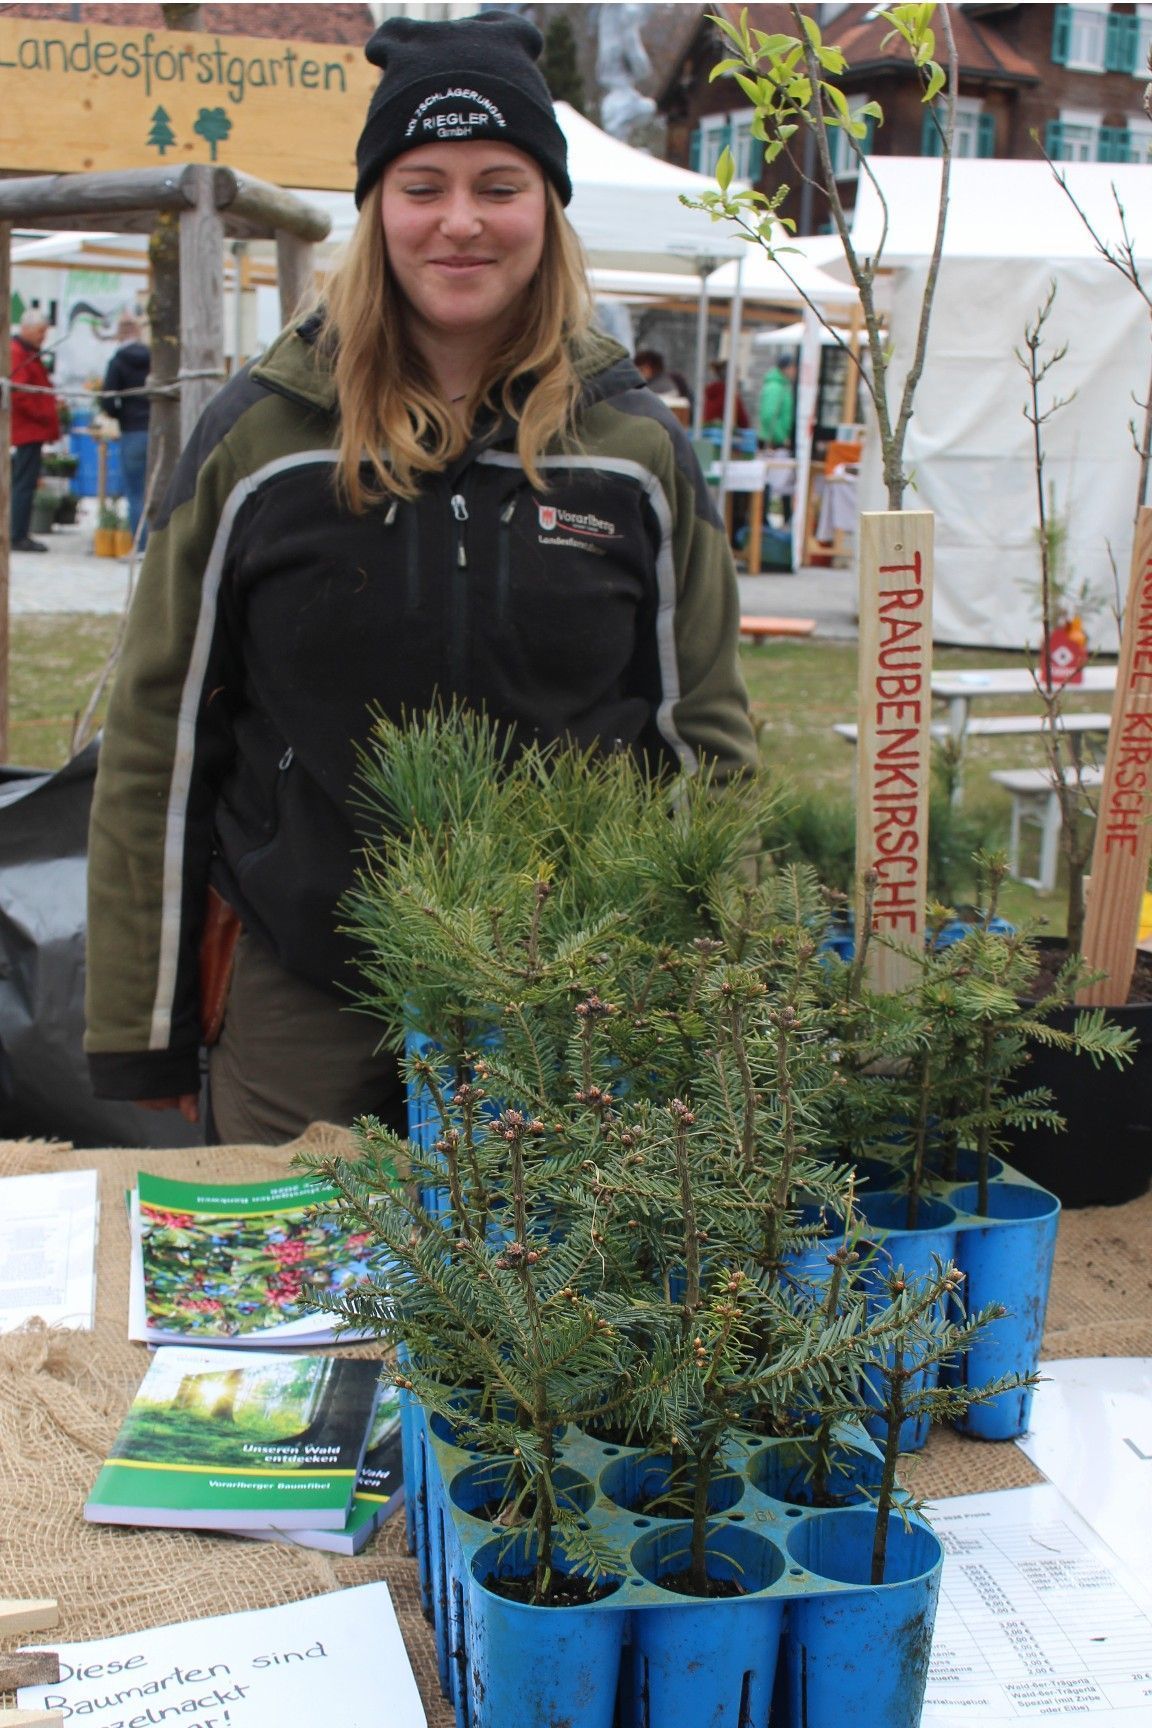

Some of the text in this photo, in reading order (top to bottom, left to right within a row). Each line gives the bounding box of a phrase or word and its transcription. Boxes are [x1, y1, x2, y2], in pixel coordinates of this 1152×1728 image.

[423, 113, 489, 130] RIEGLER
[437, 127, 472, 138] GmbH
[557, 509, 616, 535] Vorarlberg
[872, 550, 924, 934] TRAUBENKIRSCHE
[1104, 713, 1152, 857] KIRSCHE
[243, 1444, 341, 1455] Unseren Wald
[264, 1454, 338, 1463] entdecken
[208, 1480, 331, 1491] Vorarlberger Baumfibel
[58, 1654, 148, 1684] Diese
[44, 1664, 231, 1720] Baumarten
[251, 1641, 329, 1669] sind
[1040, 1707, 1062, 1715] oder
